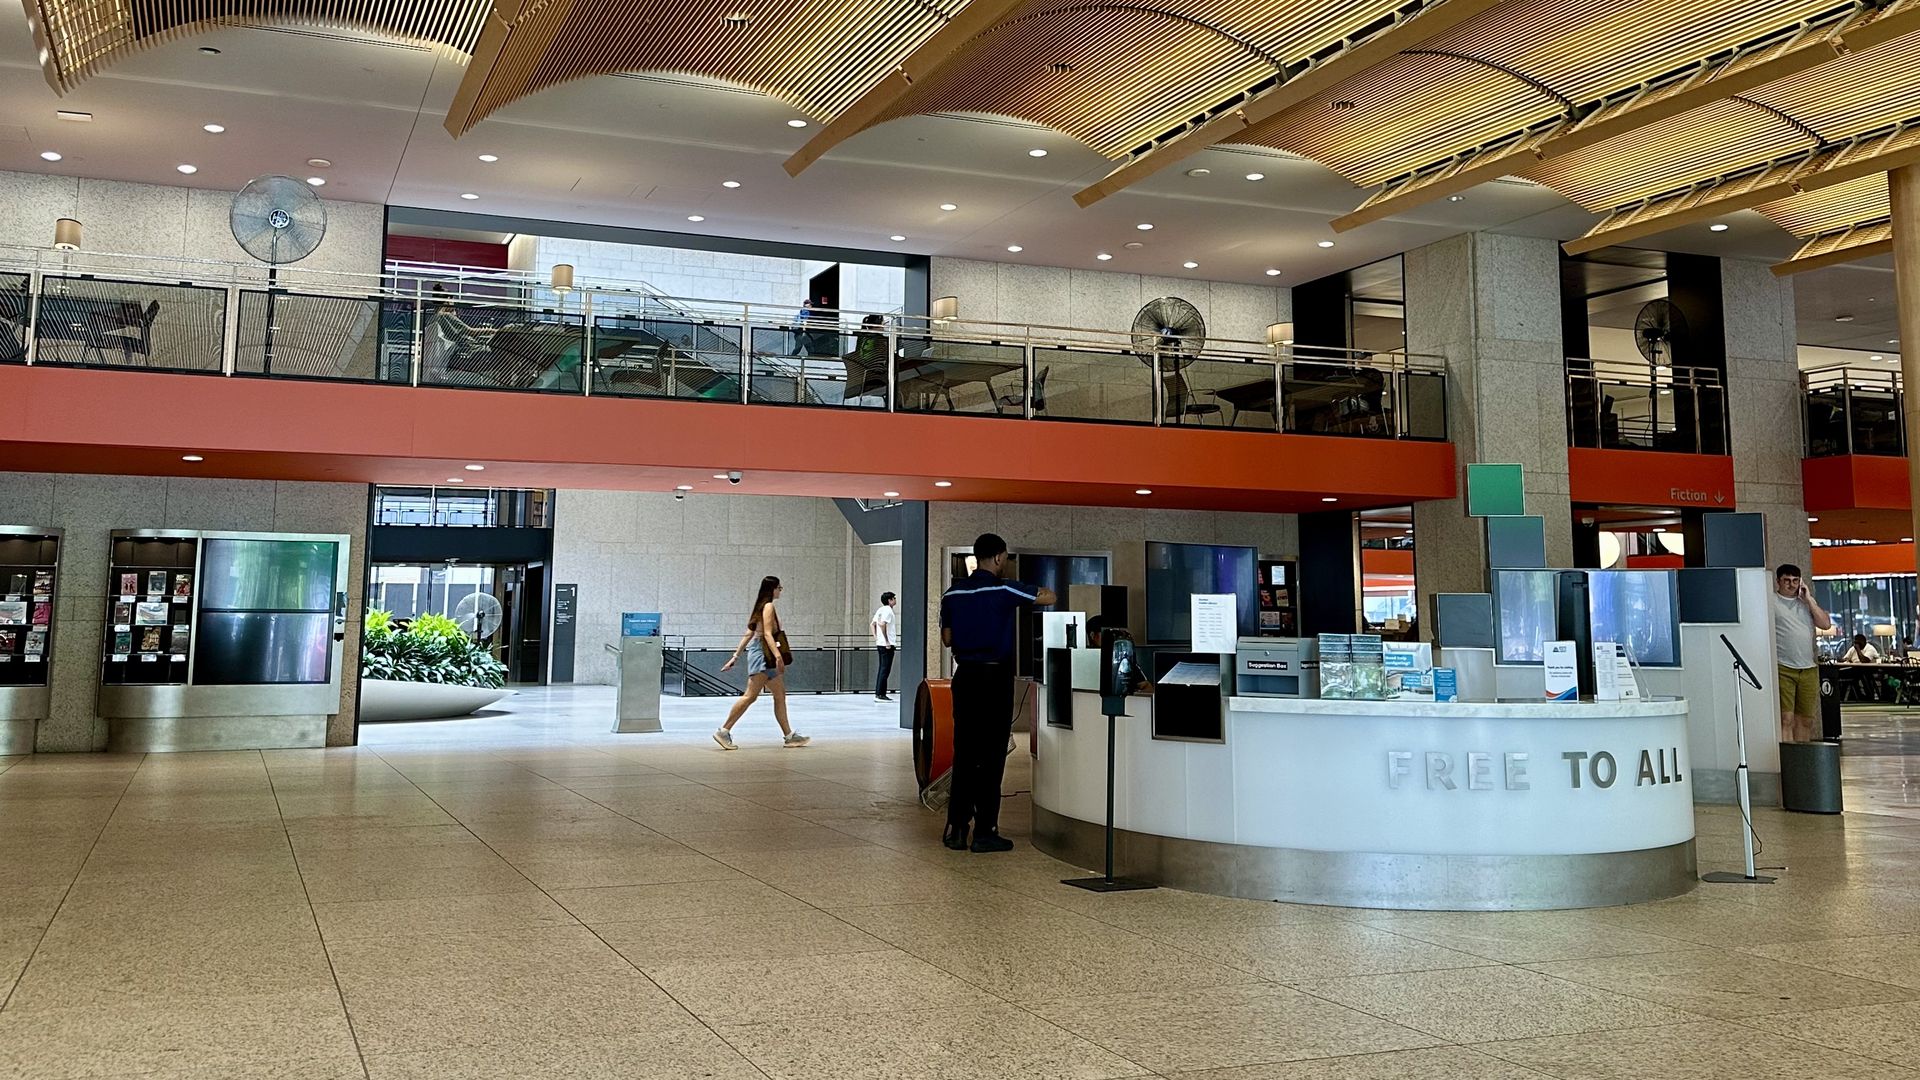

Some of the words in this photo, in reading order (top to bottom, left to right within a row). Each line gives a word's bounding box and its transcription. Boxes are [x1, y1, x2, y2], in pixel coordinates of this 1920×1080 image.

[1670, 487, 1707, 501] Fiction
[570, 586, 576, 597] 1
[1388, 751, 1531, 791] FREE
[1561, 751, 1617, 789] TO
[1637, 747, 1682, 787] ALL
